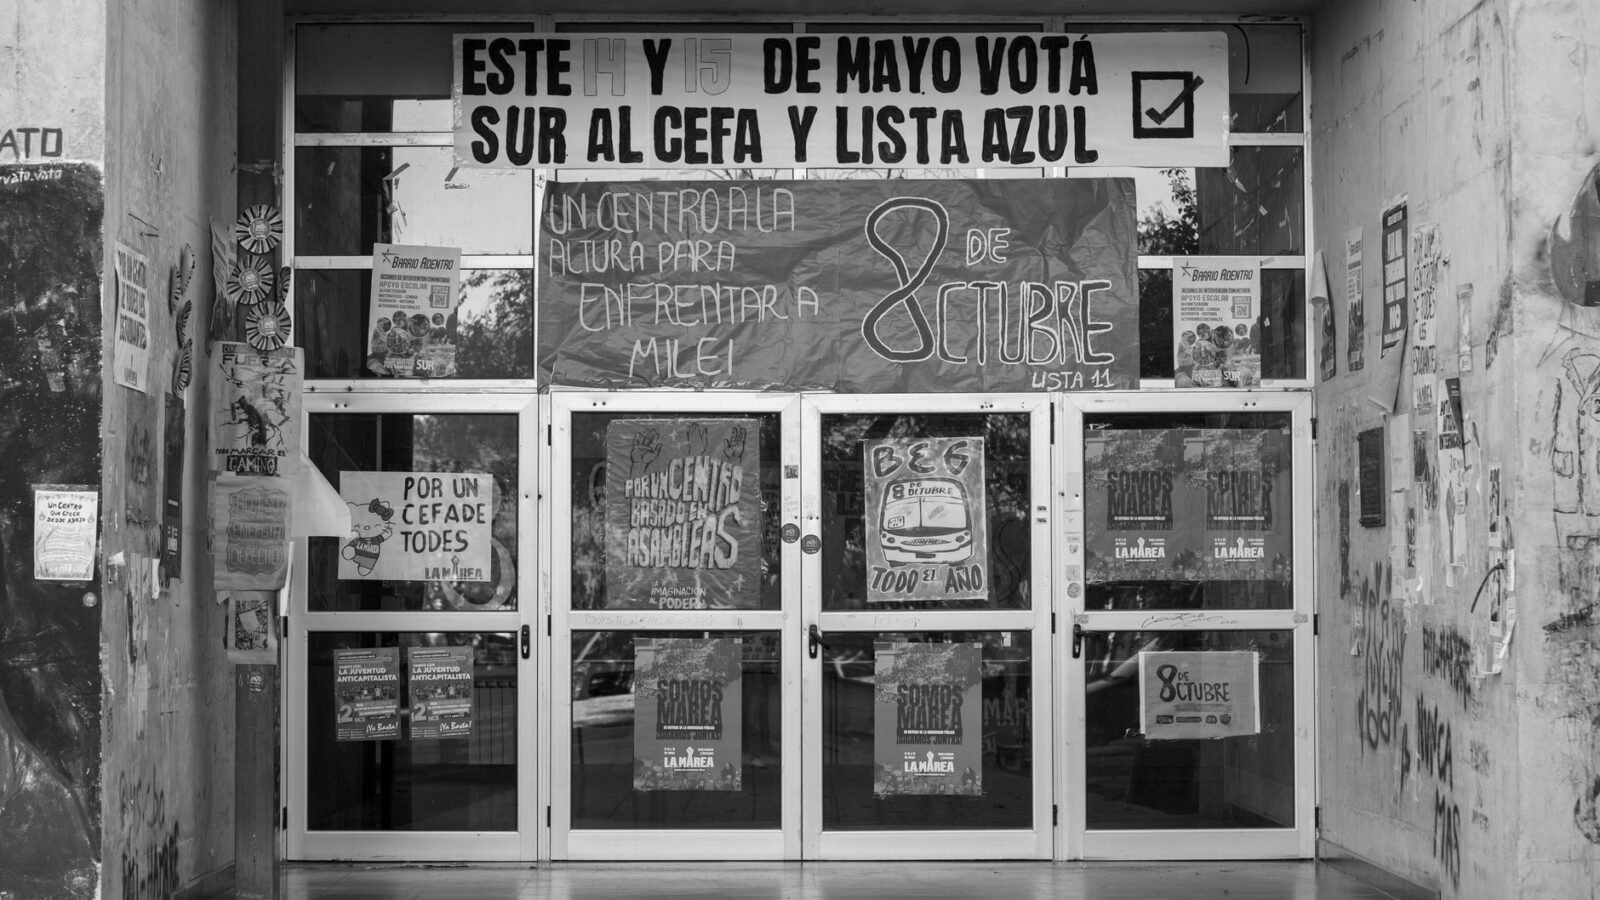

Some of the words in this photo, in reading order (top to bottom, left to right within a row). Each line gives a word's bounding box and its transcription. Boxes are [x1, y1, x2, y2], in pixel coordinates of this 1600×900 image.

[463, 38, 571, 96] ESTE
[583, 38, 626, 96] 14
[643, 38, 671, 96] Y
[684, 38, 732, 95] 15
[763, 37, 821, 94] DE
[837, 36, 961, 94] MAYO
[975, 34, 1098, 96] VOTÁ
[471, 106, 567, 165] SUR
[587, 106, 643, 163] AL
[653, 106, 762, 163] CEFA
[788, 106, 817, 162] Y
[836, 106, 969, 164] LISTA
[982, 105, 1098, 164] AZUL
[550, 193, 586, 234] UN
[597, 188, 719, 233] CENTRO
[550, 238, 644, 277] ALTURA
[658, 240, 735, 272] PARA
[967, 228, 1010, 265] DE
[401, 282, 428, 290] ESCOLAR
[579, 282, 788, 331] ENFRENTAR
[798, 286, 818, 317] A
[629, 337, 733, 378] MILEI
[1032, 371, 1083, 391] LISTA
[1091, 368, 1115, 388] 11
[231, 447, 275, 456] MARCAR
[229, 456, 275, 474] CAMINO
[404, 476, 443, 500] POR
[453, 477, 478, 498] UN
[625, 475, 649, 498] POR
[650, 471, 668, 499] UN
[668, 455, 744, 513] CENTRO
[892, 484, 905, 499] 8
[908, 487, 953, 496] OCTUBRE
[1107, 471, 1173, 492] SOMOS
[631, 498, 686, 527] BASADO
[689, 501, 708, 522] EN
[1107, 491, 1173, 516] MAREA
[400, 530, 469, 553] TODES
[627, 505, 742, 569] ASAMBLEAS
[1115, 547, 1128, 558] LA
[1129, 546, 1165, 558] MAREA
[1214, 547, 1227, 558] LA
[1228, 546, 1264, 558] MAREA
[871, 565, 919, 593] TODO
[945, 564, 983, 594] AÑO
[659, 597, 704, 609] PODER
[337, 675, 397, 683] ANTICAPITALISTA
[349, 667, 386, 675] JUVENTUD
[411, 673, 471, 681] ANTICAPITALISTA
[1178, 671, 1189, 681] DE
[657, 679, 723, 702] SOMOS
[897, 684, 963, 707] SOMOS
[339, 704, 353, 723] 2
[413, 703, 427, 721] 2
[657, 701, 723, 727] MAREA
[897, 706, 963, 732] MAREA
[664, 756, 677, 768] LA
[678, 756, 714, 768] MAREA
[904, 761, 917, 772] LA
[918, 760, 954, 772] MAREA
